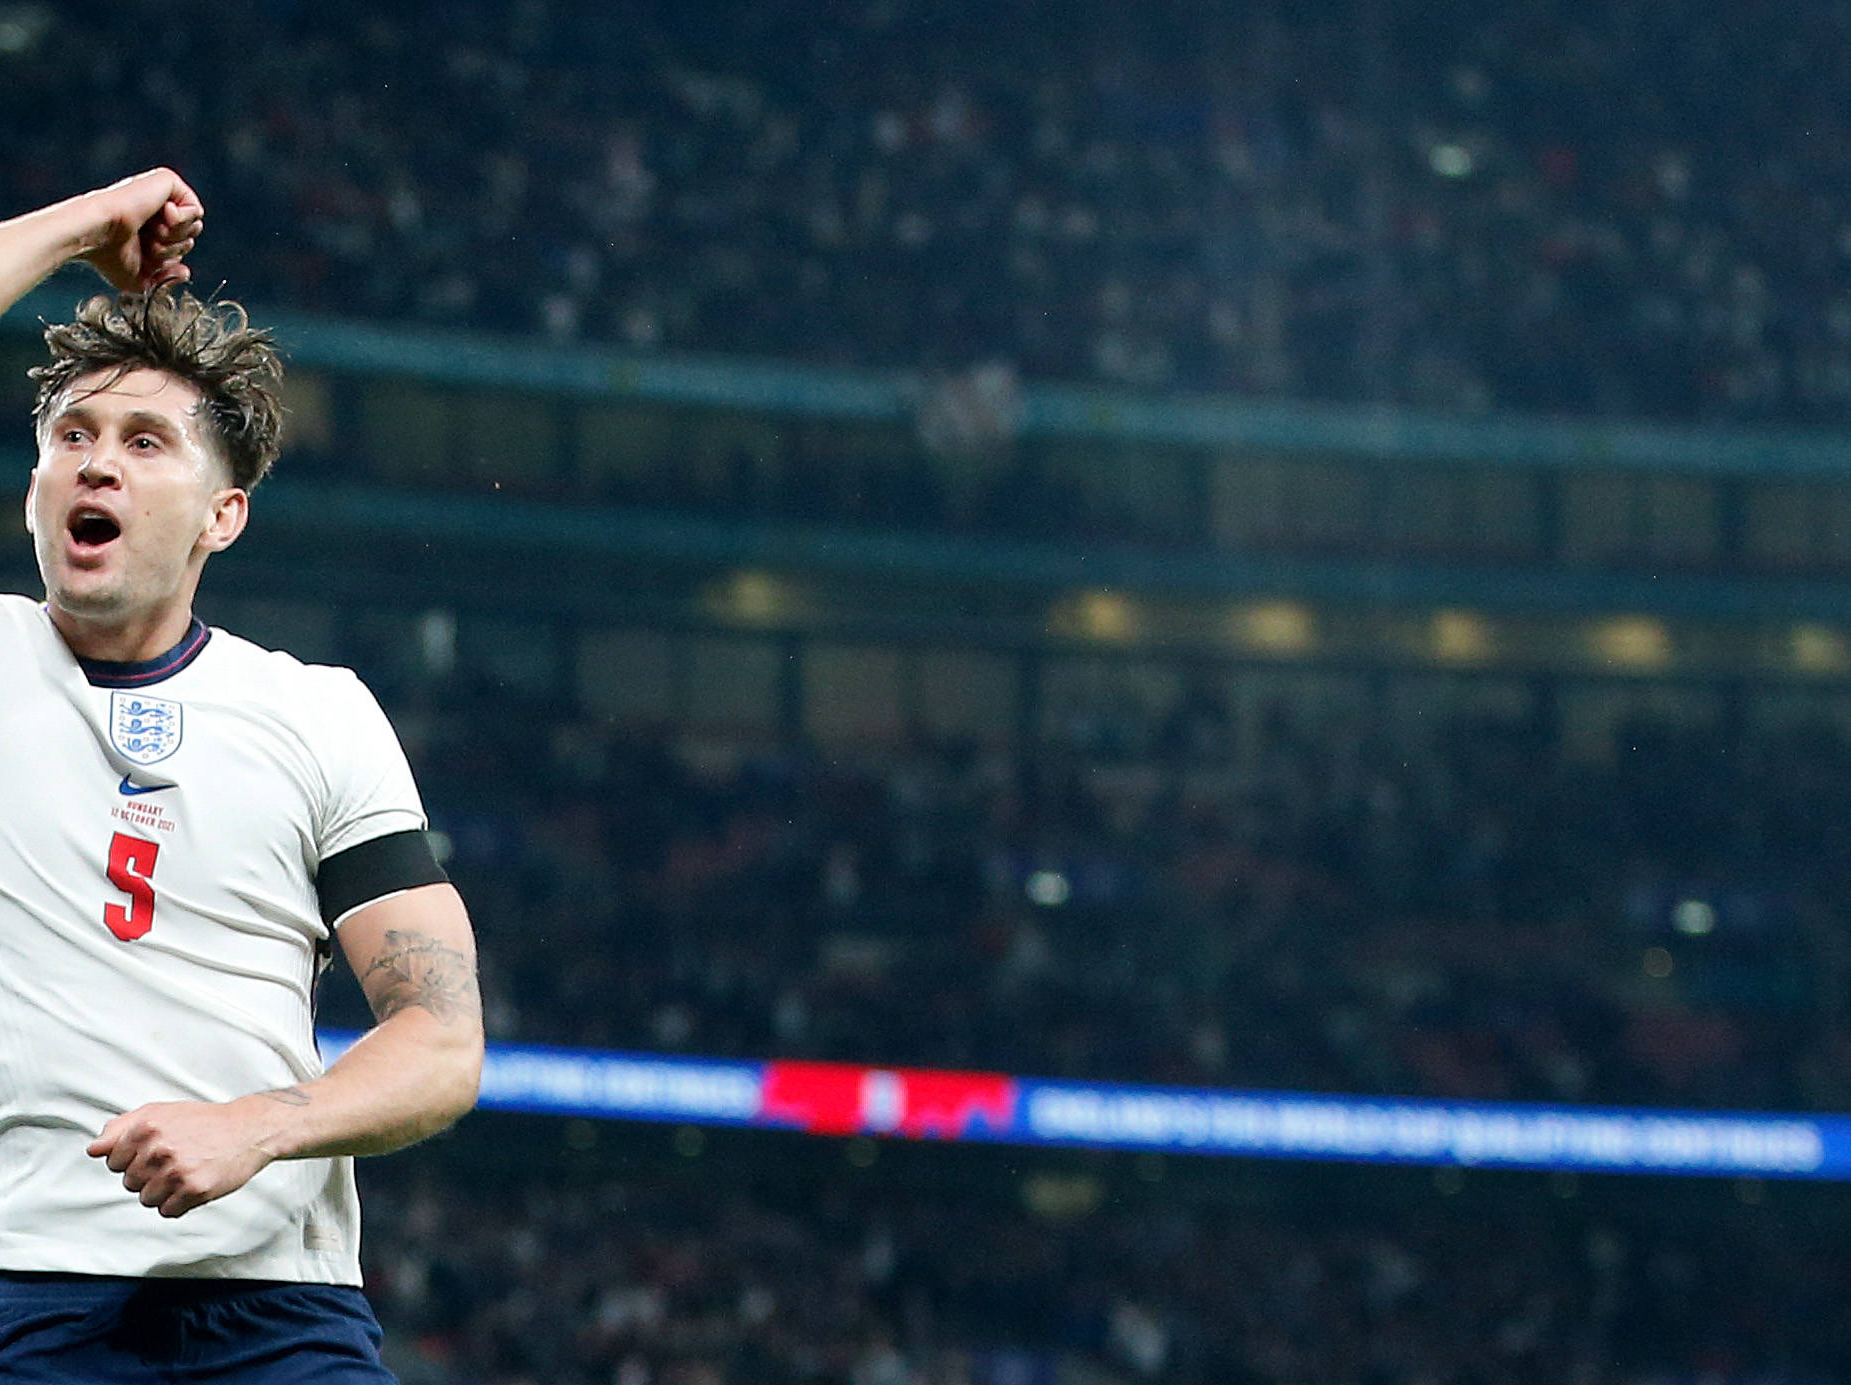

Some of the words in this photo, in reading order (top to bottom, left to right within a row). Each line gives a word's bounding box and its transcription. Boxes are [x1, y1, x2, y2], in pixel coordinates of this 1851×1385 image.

[127, 800, 164, 817] HUNGARY
[121, 810, 156, 827] OCTOBER
[103, 831, 160, 942] 5
